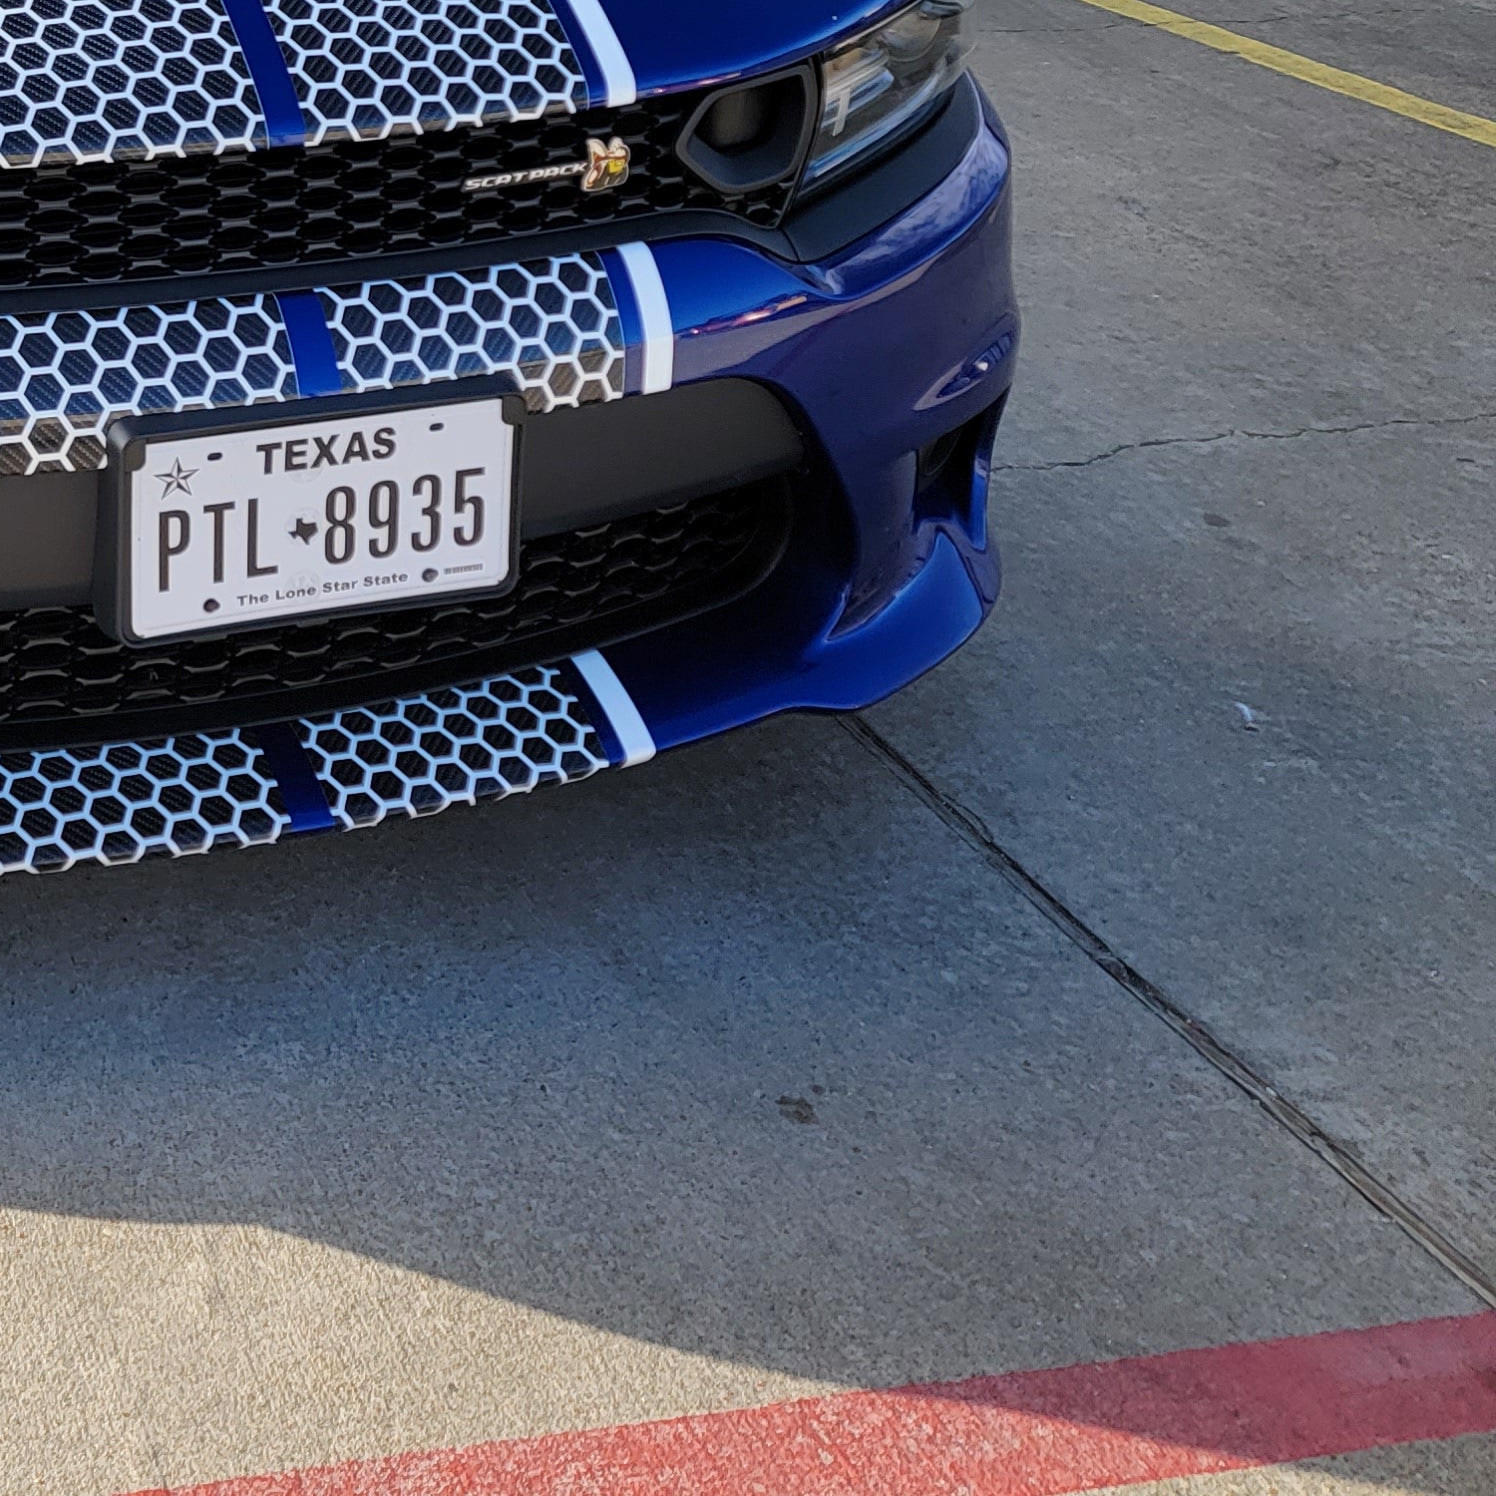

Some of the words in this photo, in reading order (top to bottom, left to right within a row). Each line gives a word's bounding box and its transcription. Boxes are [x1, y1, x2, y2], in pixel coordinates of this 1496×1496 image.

[464, 171, 528, 190] SCAT
[528, 162, 588, 181] PACK
[256, 427, 397, 475] TEXAS
[159, 498, 279, 592] PTL
[325, 467, 486, 564] 8935
[237, 591, 270, 607] The
[275, 585, 317, 601] Lone
[322, 578, 359, 594] Star
[364, 572, 409, 588] State
